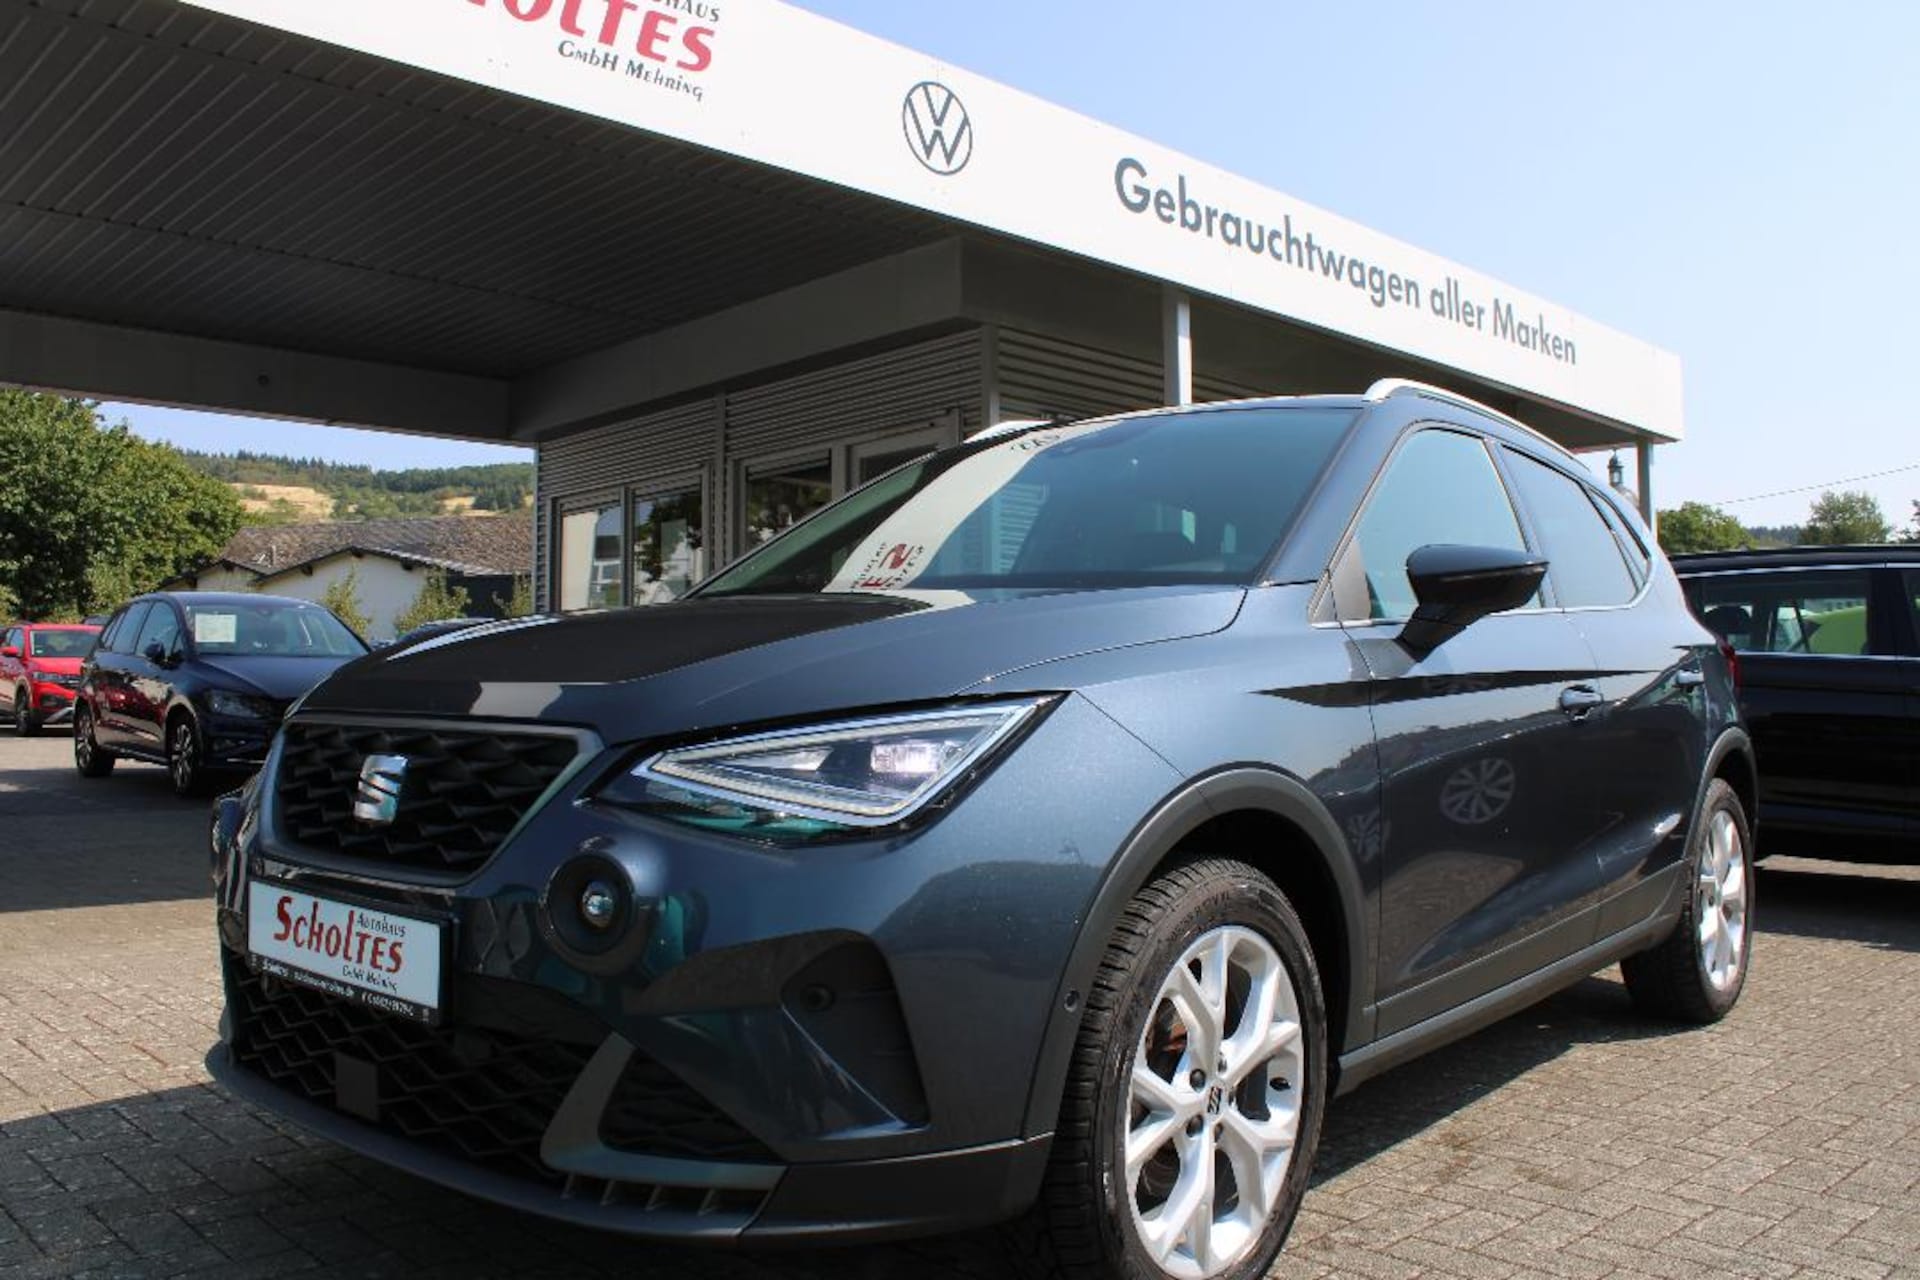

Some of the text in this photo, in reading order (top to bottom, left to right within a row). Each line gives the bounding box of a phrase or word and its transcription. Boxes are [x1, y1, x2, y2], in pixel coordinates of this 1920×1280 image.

[1114, 157, 1576, 365] Gebrauchtwagen aller Marken
